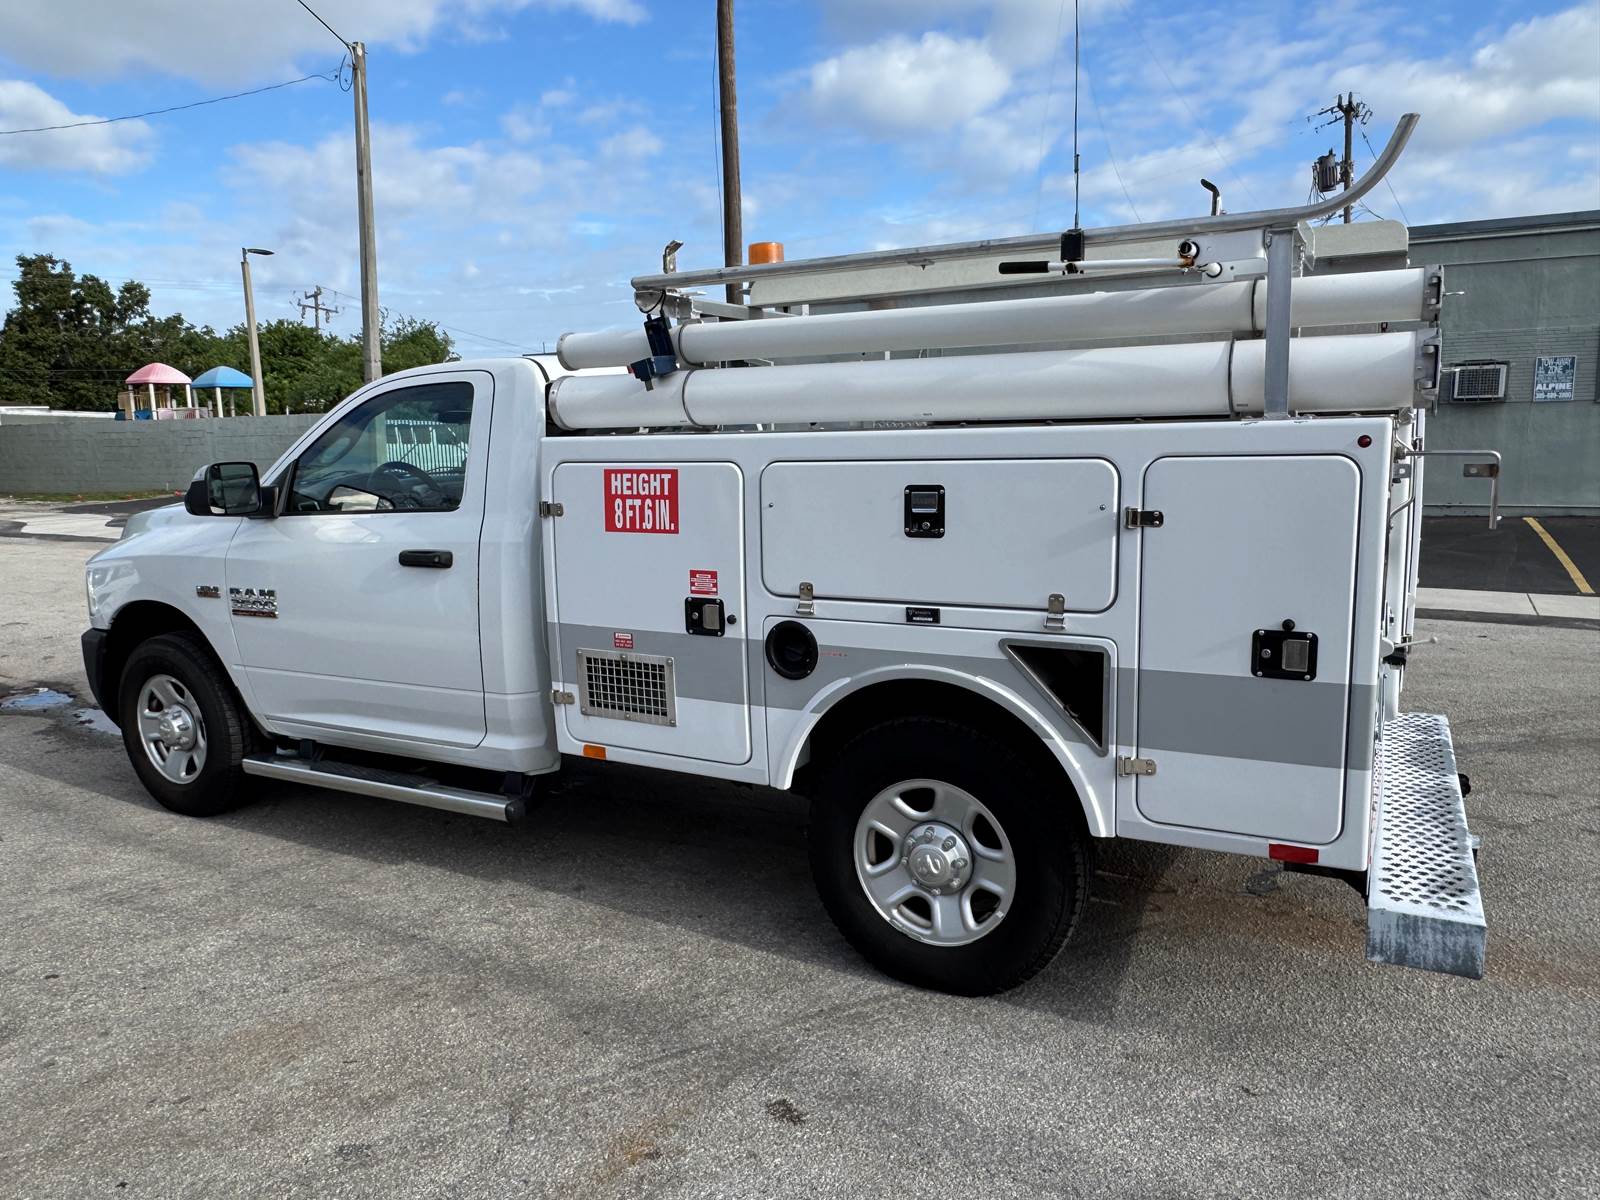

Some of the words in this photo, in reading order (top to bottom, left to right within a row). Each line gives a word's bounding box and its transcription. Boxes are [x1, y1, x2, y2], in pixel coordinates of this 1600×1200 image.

[1536, 383, 1572, 391] ALPINE
[611, 473, 672, 496] HEIGHT
[229, 587, 276, 599] RAM
